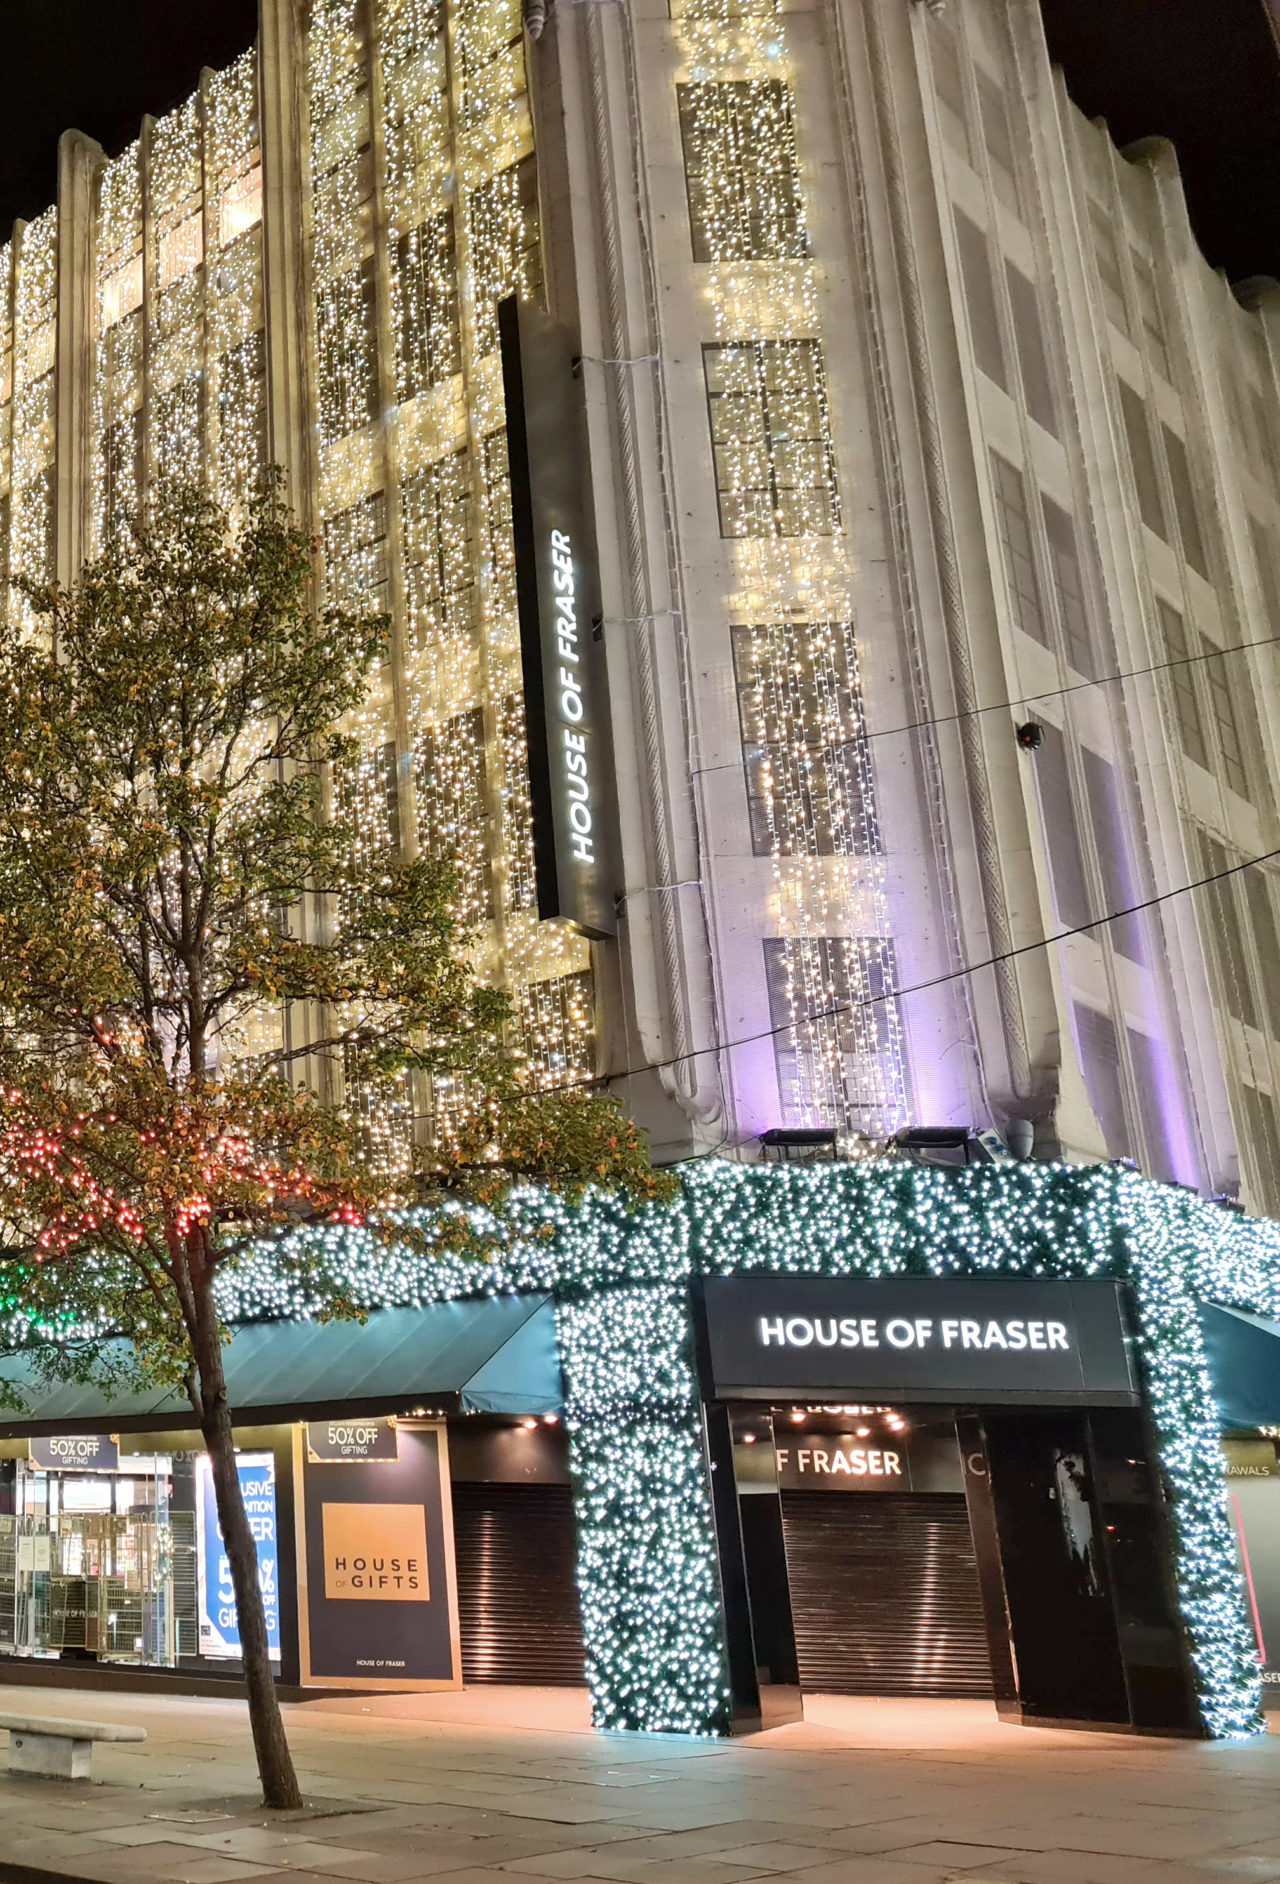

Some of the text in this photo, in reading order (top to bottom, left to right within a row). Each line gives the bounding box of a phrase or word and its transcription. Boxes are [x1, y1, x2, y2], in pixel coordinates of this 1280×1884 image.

[551, 528, 594, 864] HOUSE OF FRASER
[761, 1317, 1069, 1350] HOUSE OF FRASER
[328, 1427, 378, 1445] 50% OFF
[49, 1440, 100, 1457] 50% OFF
[341, 1445, 368, 1455] GIFTING
[61, 1456, 88, 1465] GIFTING
[797, 1449, 902, 1476] FRASER
[240, 1481, 273, 1497] USIVE
[335, 1557, 418, 1572] HOUSE
[218, 1557, 275, 1604] 5%
[335, 1574, 419, 1590] OF GIFTS
[218, 1607, 276, 1630] GIFG
[356, 1659, 375, 1667] HOUSE
[385, 1660, 406, 1668] FRASER
